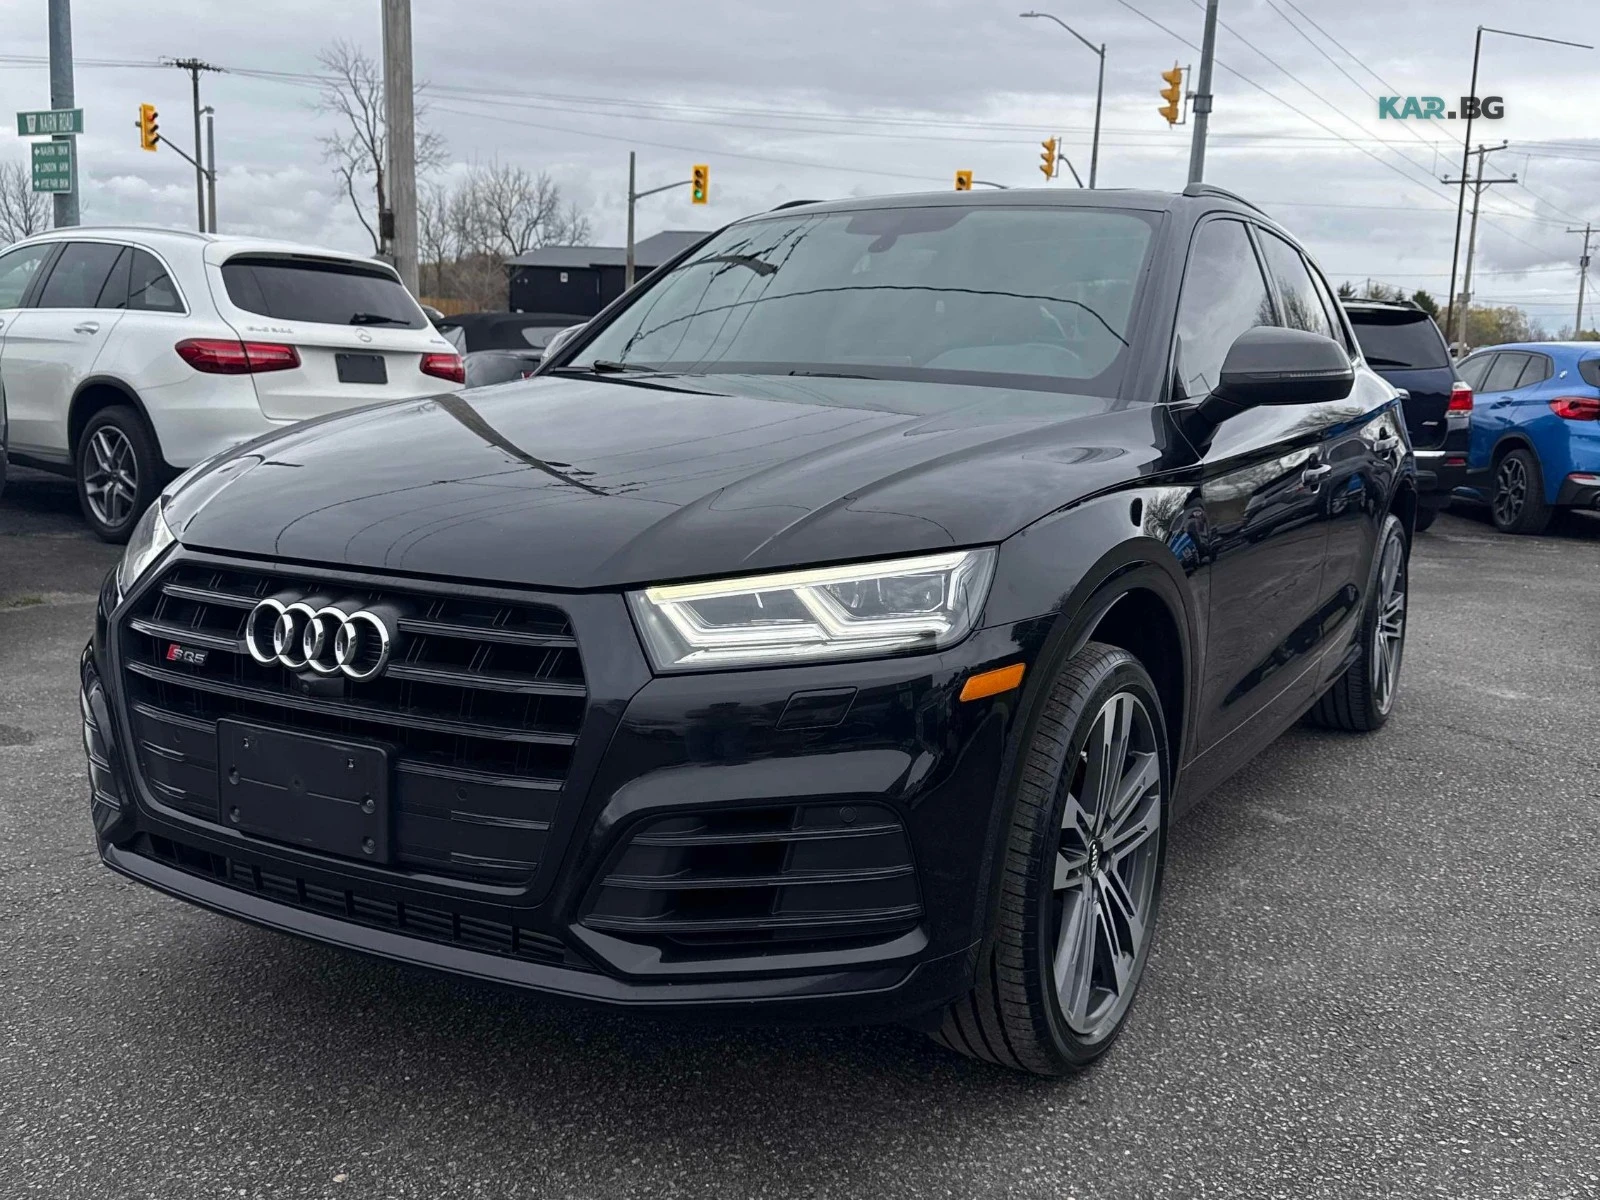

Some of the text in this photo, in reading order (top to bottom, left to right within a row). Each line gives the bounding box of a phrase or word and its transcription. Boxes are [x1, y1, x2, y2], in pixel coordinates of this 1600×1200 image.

[39, 114, 57, 132] NAIRN
[59, 112, 73, 131] ROAD
[40, 162, 57, 173] LONDON
[172, 648, 206, 664] SQ5
